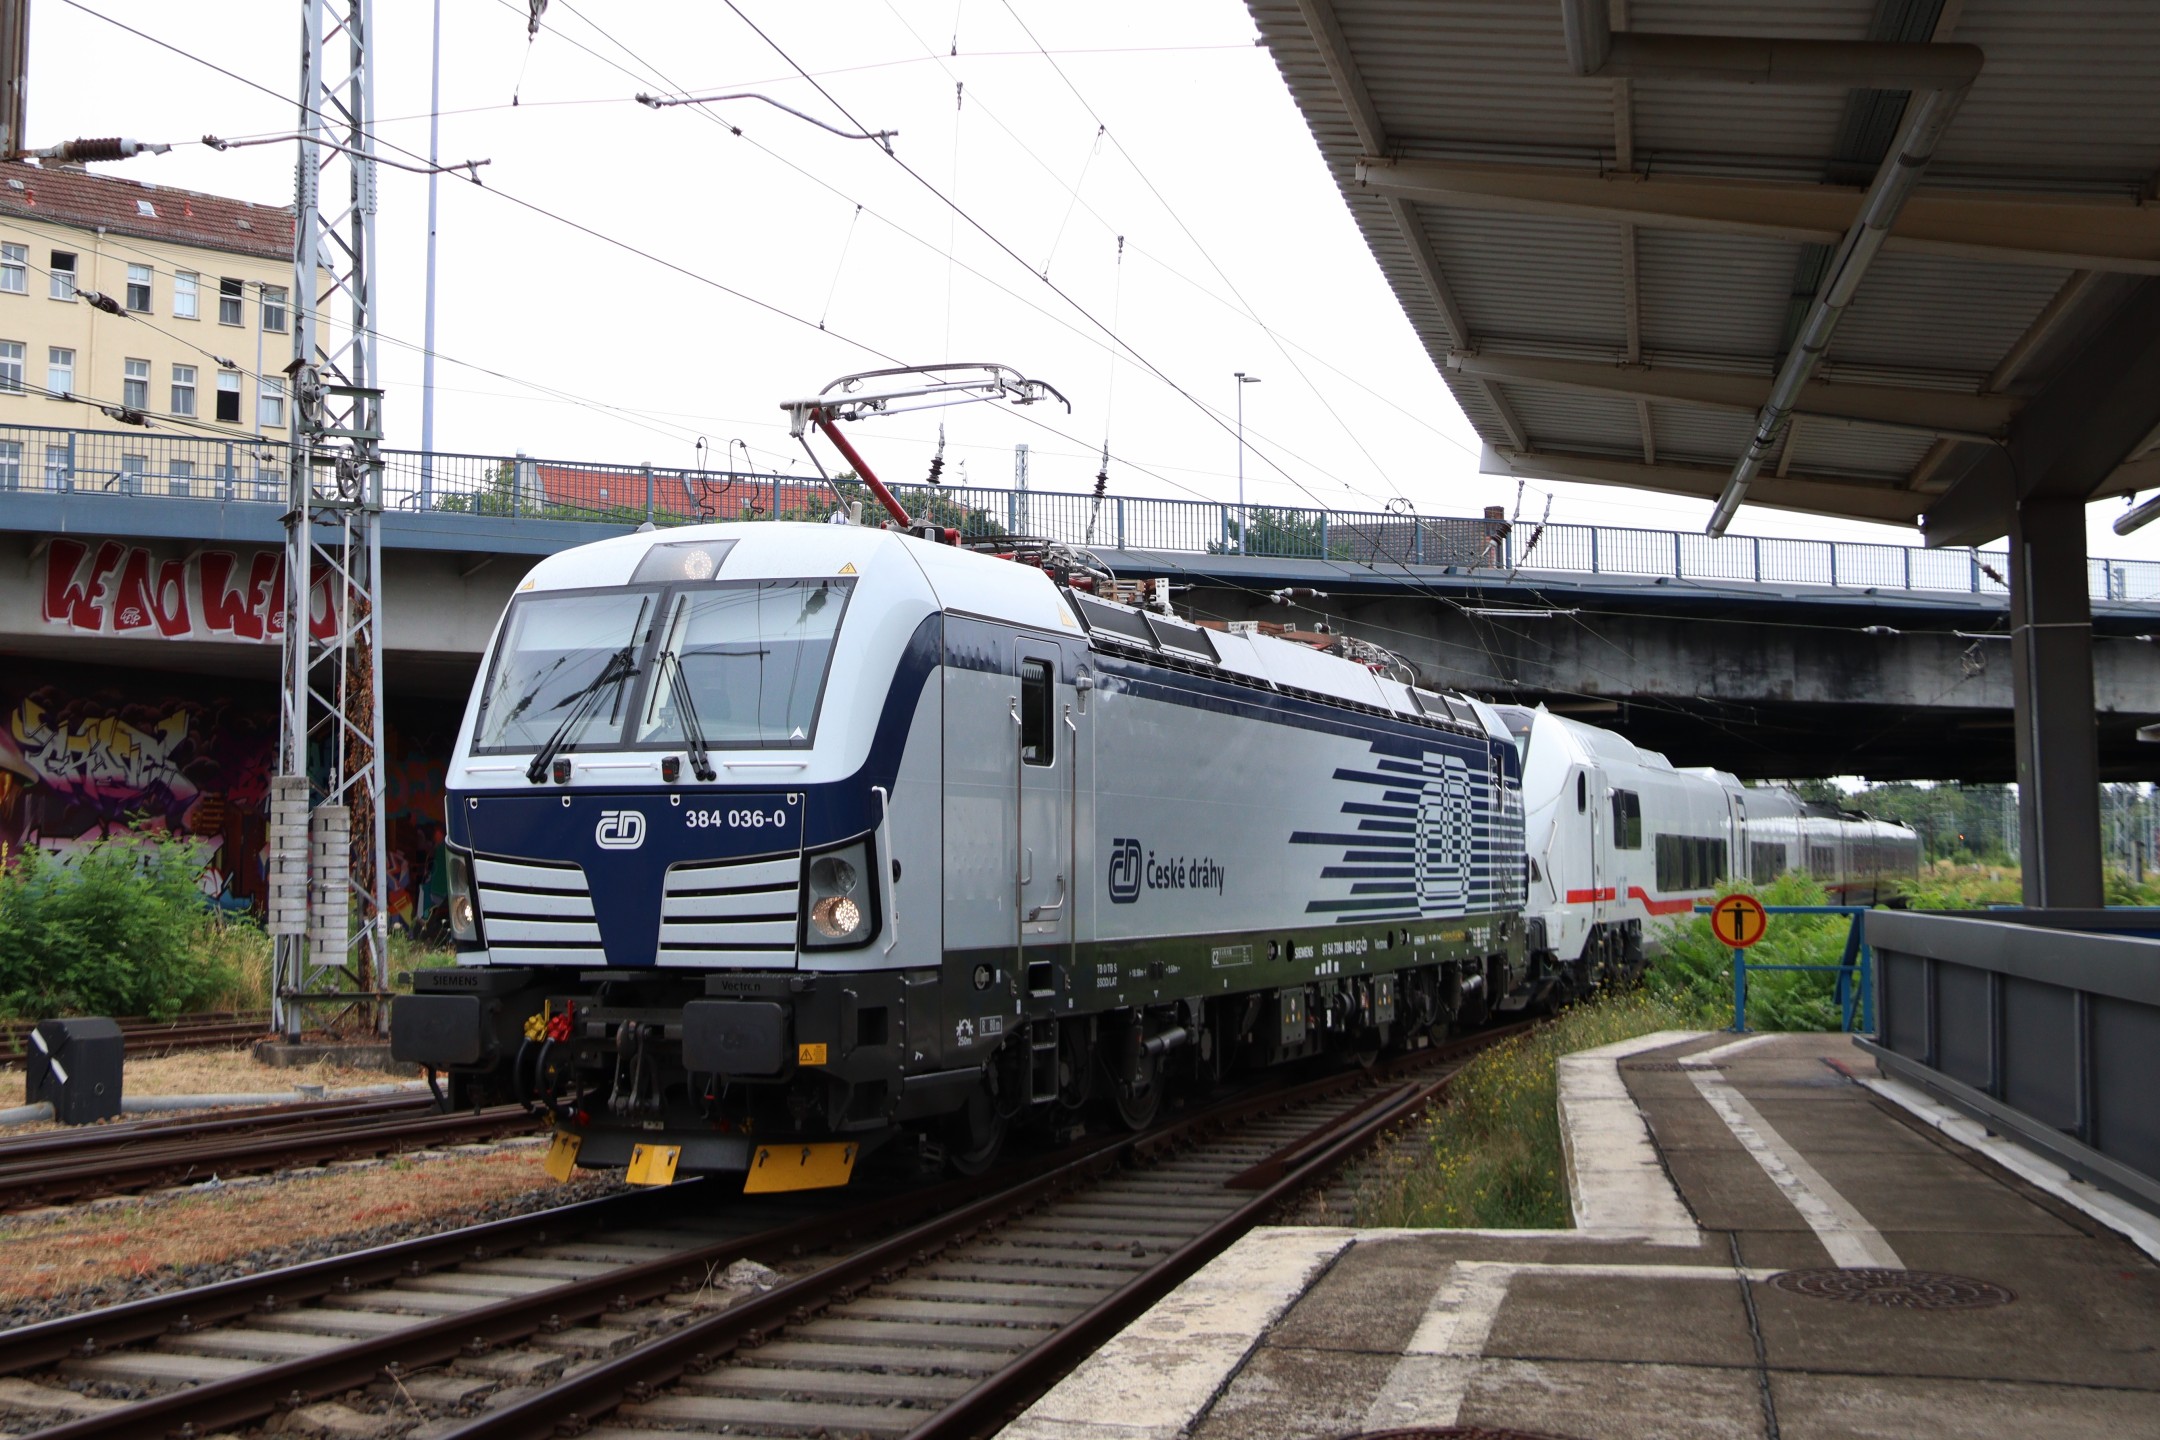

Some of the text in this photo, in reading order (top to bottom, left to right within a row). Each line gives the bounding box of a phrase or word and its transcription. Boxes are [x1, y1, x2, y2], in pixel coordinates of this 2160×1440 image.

[685, 809, 786, 828] 384 036-0
[1146, 850, 1225, 896] České dráhy
[1295, 946, 1314, 959] SIEMENS
[433, 975, 478, 987] SIEMENS
